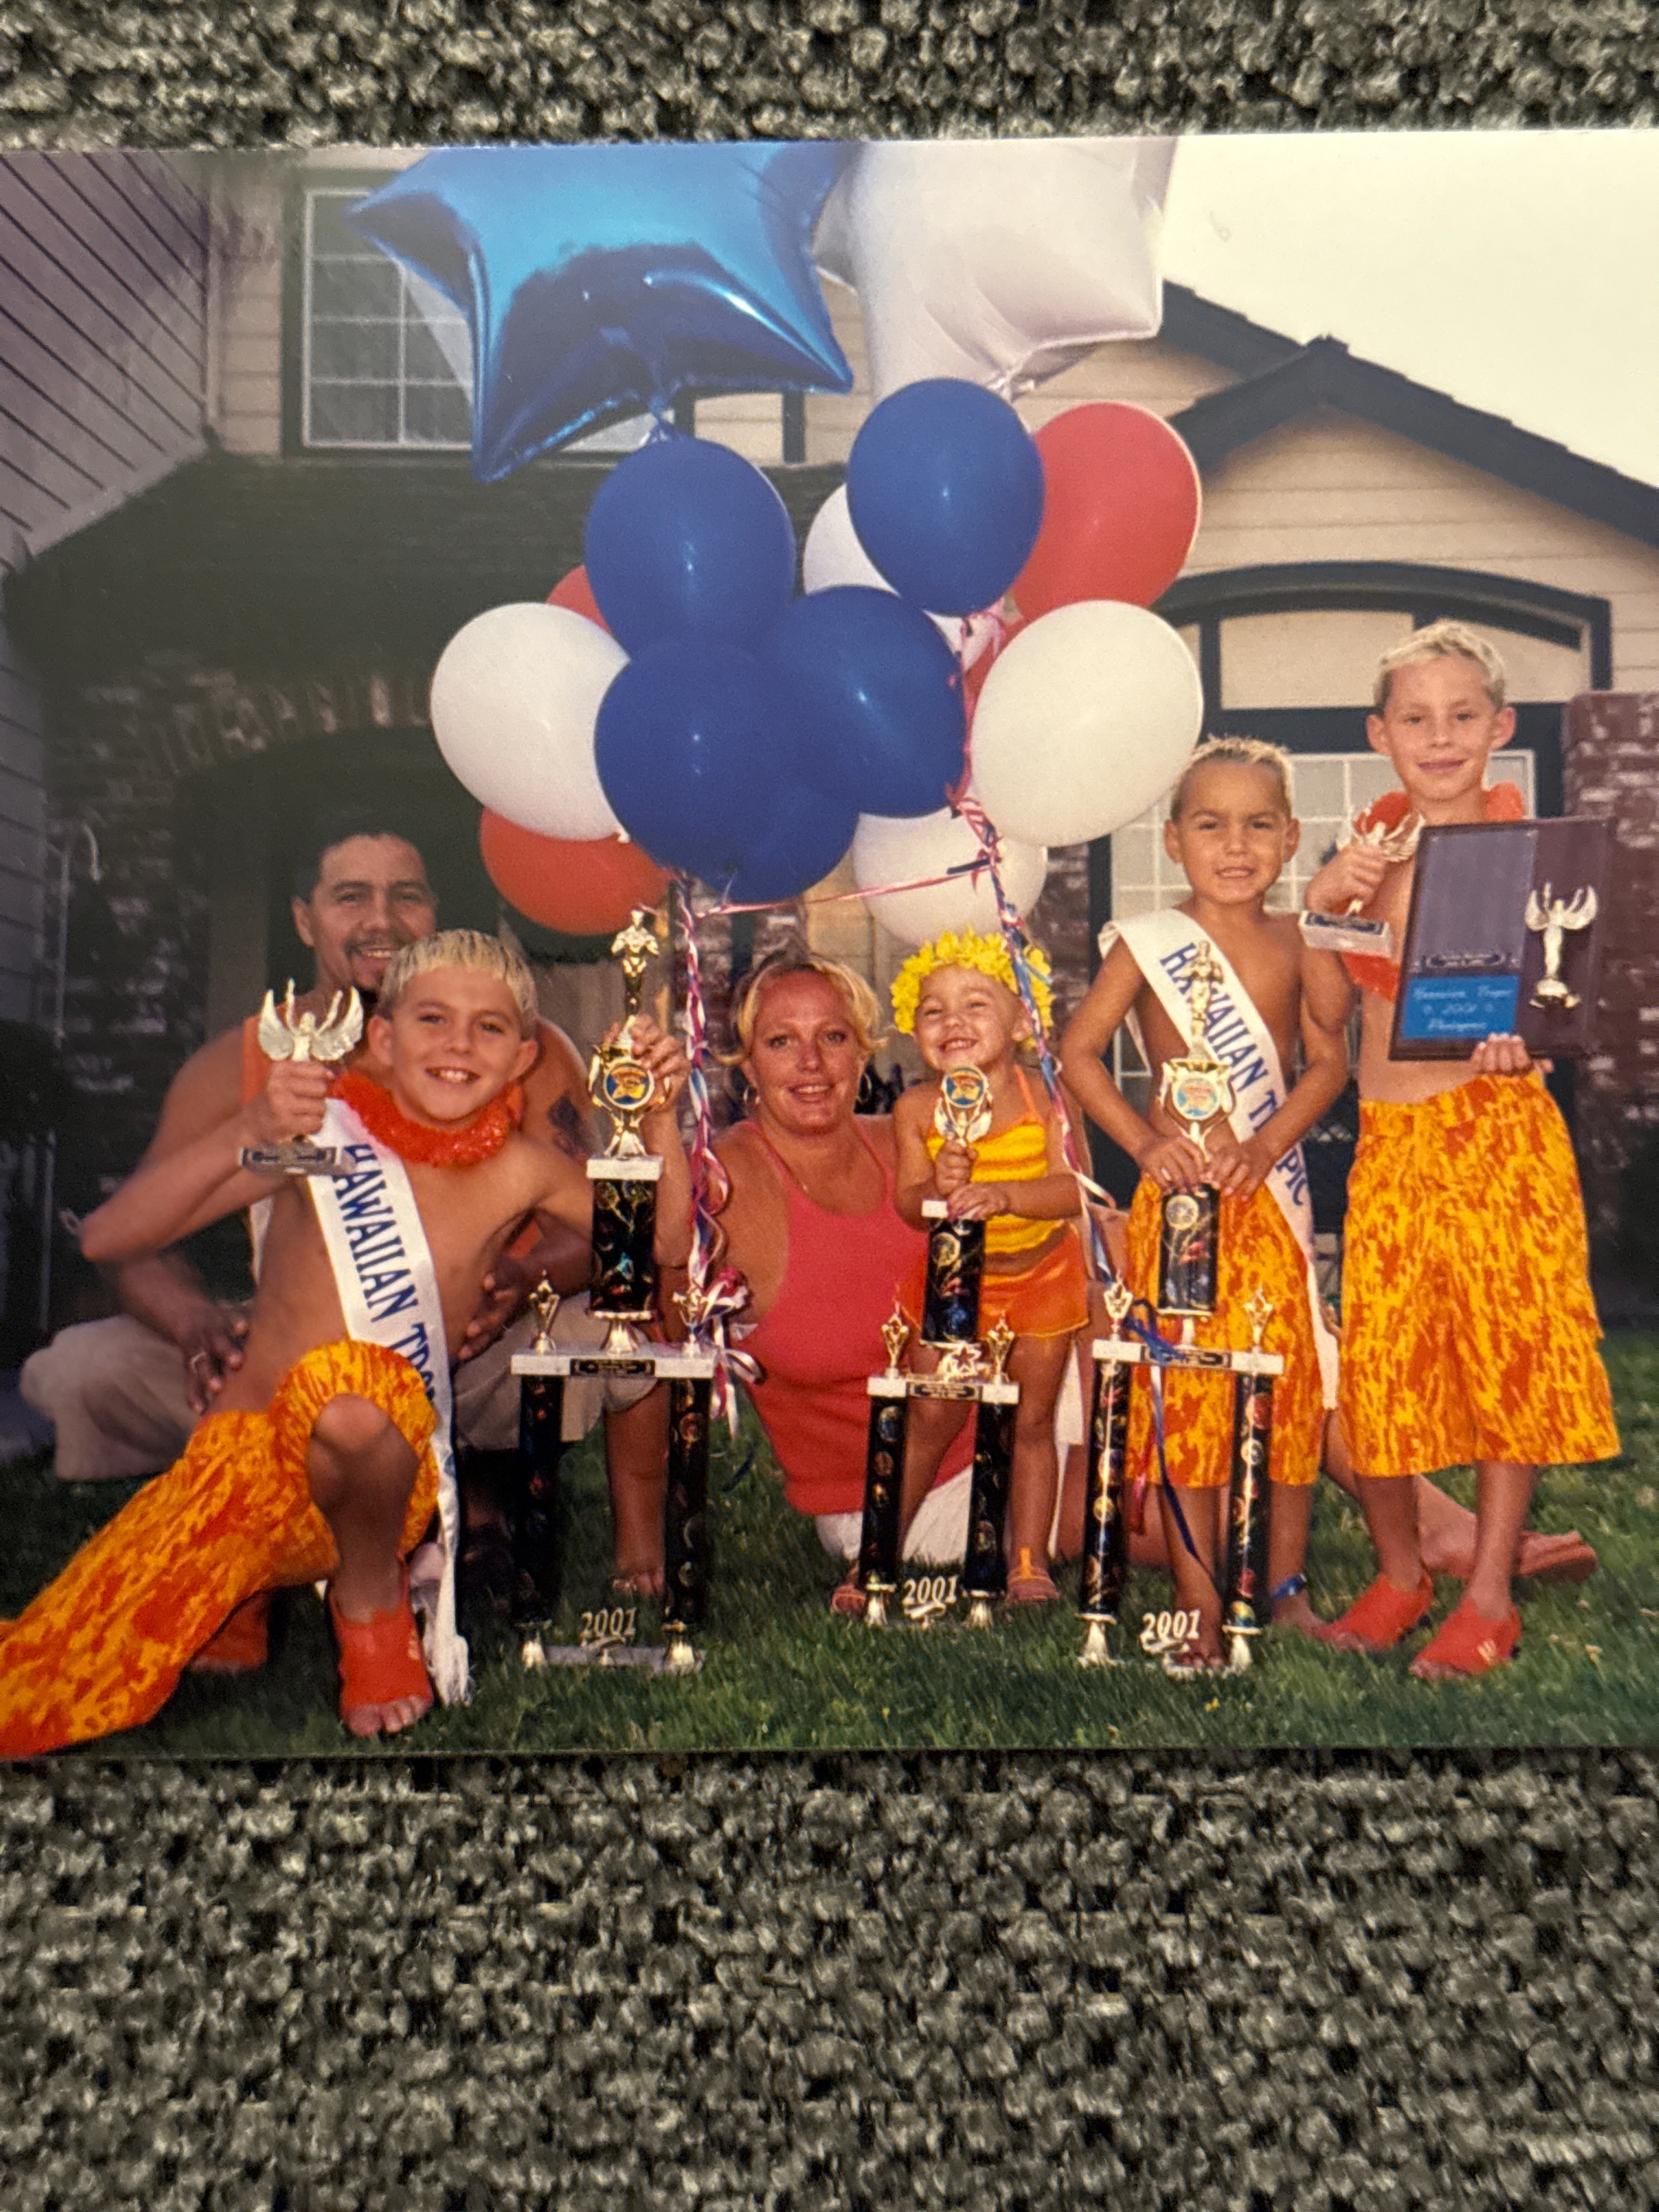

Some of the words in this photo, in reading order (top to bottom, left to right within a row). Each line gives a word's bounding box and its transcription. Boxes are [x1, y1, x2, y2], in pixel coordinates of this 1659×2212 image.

[331, 1144, 419, 1323] HAWAIIAN
[902, 1575, 958, 1606] 2001
[579, 1607, 636, 1638] 2001
[1139, 1609, 1201, 1640] 2001
